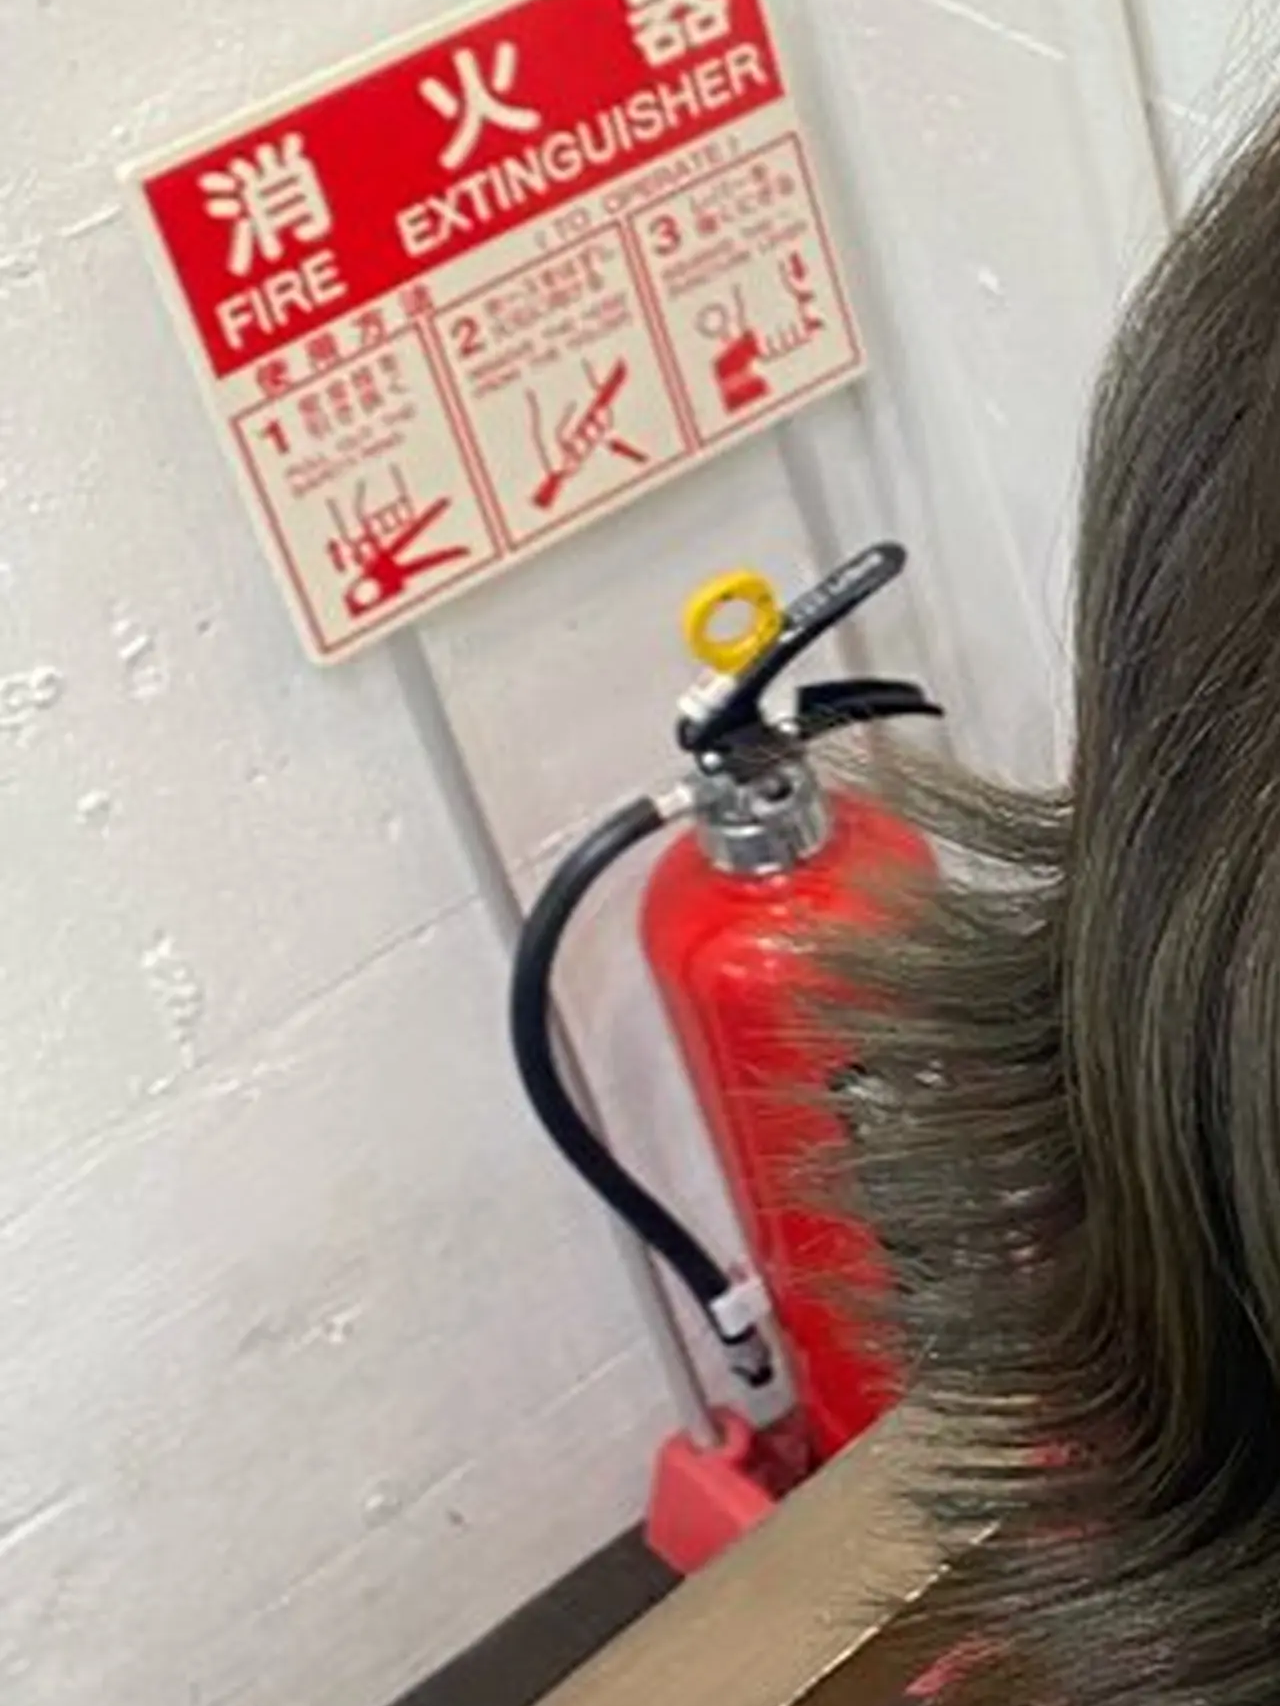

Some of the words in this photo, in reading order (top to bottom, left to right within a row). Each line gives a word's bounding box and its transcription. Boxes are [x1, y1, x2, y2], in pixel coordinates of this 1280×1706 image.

[214, 249, 348, 351] FIRE
[397, 43, 769, 257] EXTINGUISHER
[650, 215, 683, 257] 3
[450, 316, 487, 358] 2
[259, 420, 292, 456] 1
